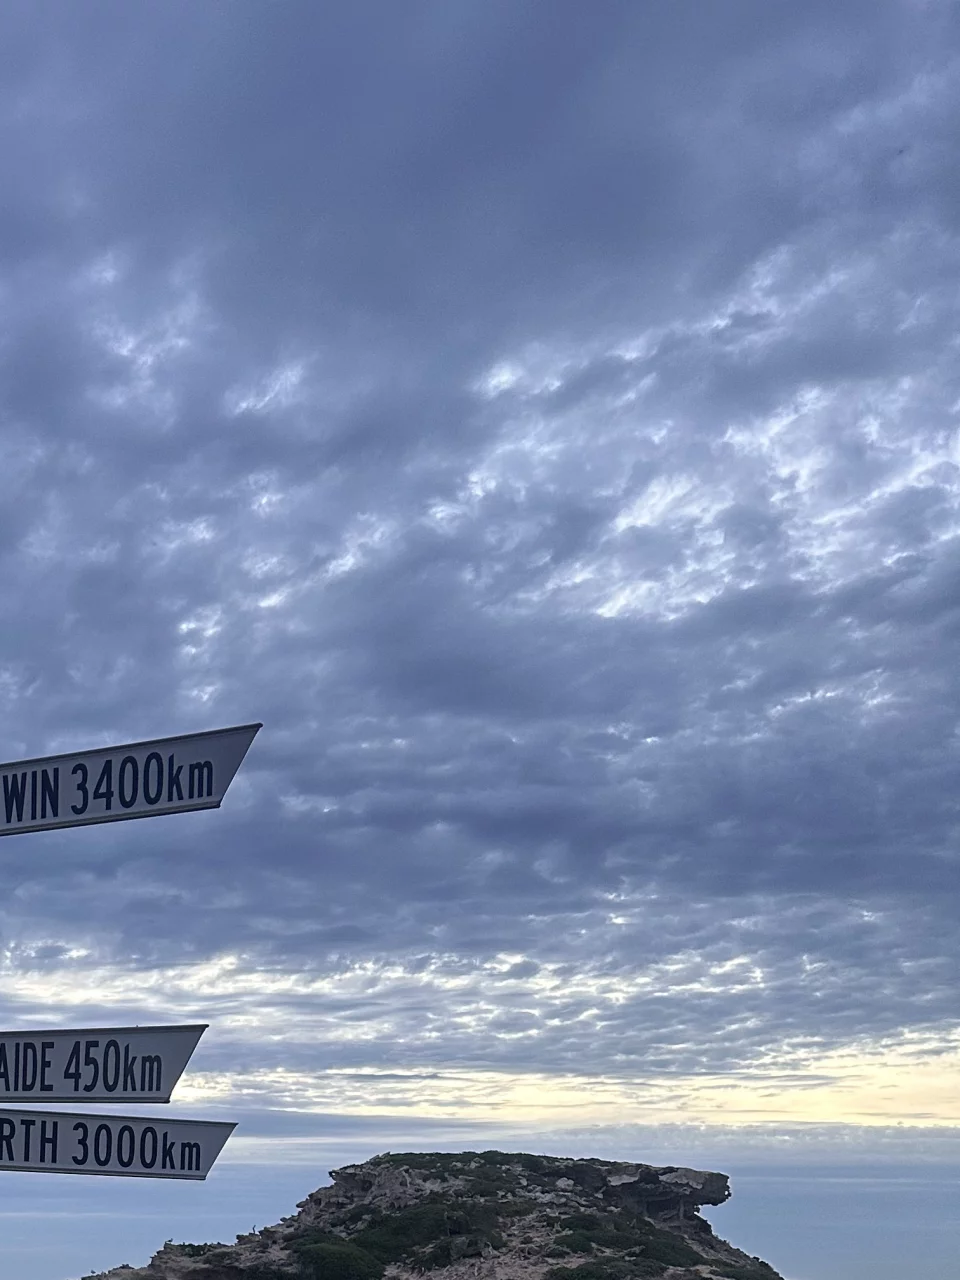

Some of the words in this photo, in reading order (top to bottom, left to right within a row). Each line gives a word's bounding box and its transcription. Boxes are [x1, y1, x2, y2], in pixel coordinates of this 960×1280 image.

[71, 752, 214, 815] 3400km
[64, 1039, 162, 1093] 450km
[72, 1121, 201, 1171] 3000km
